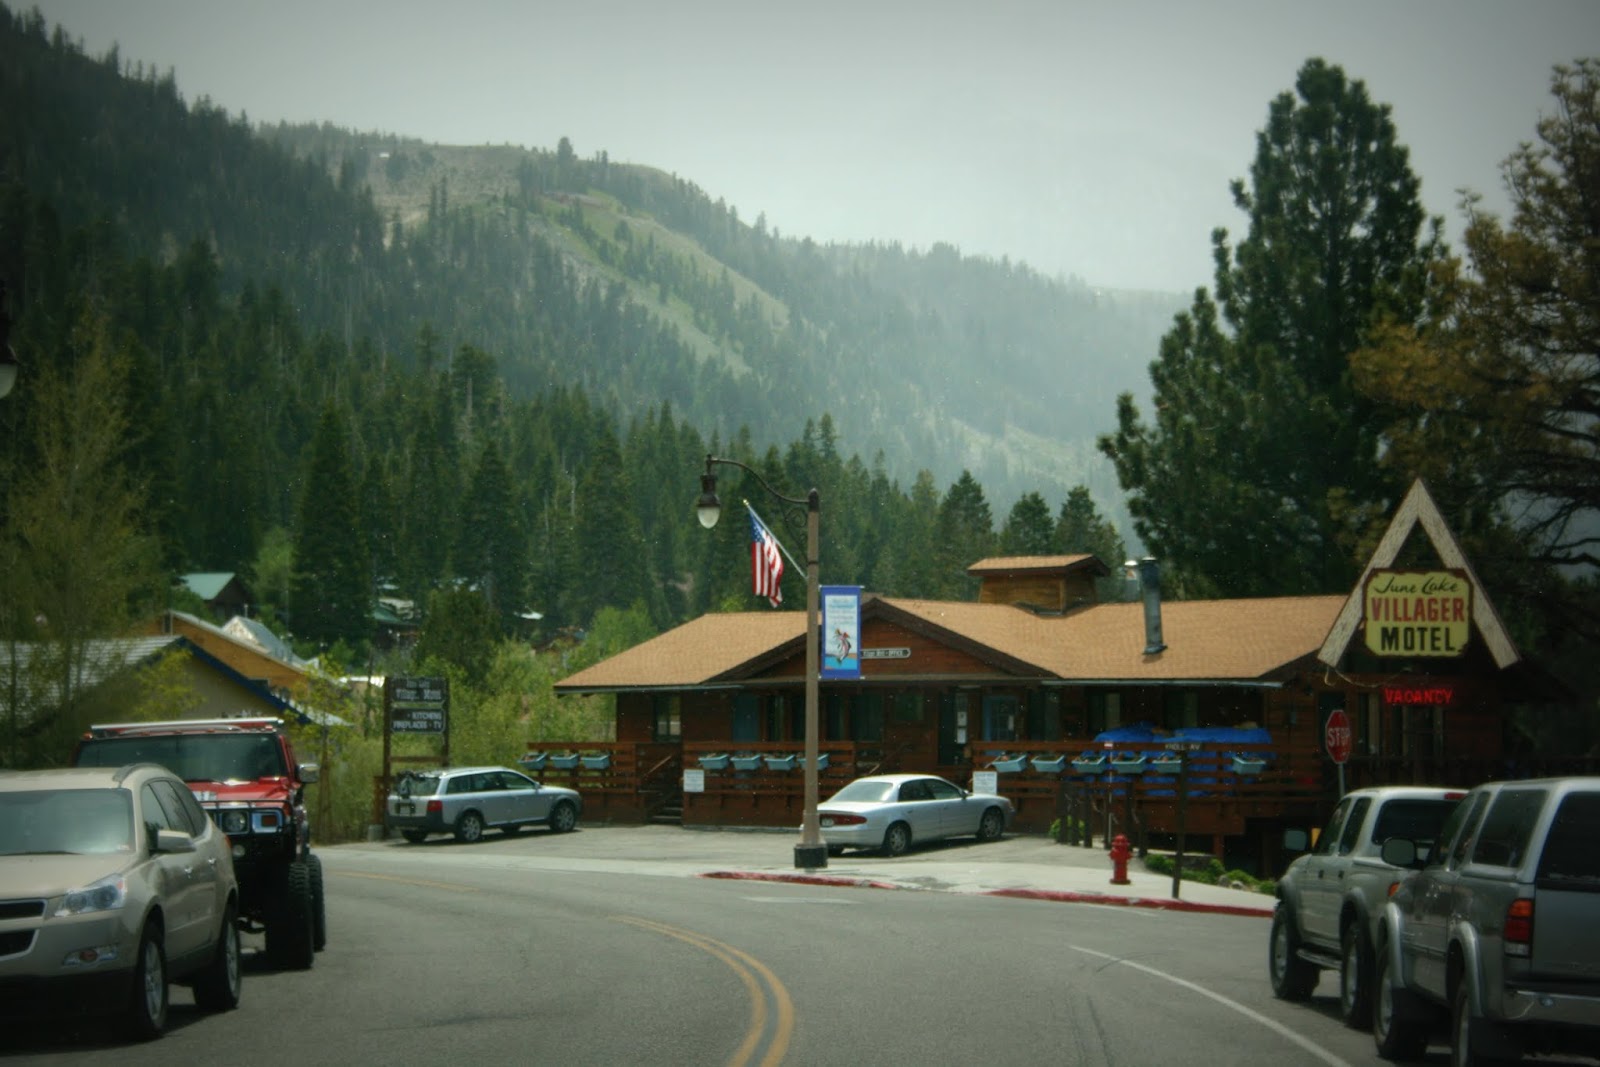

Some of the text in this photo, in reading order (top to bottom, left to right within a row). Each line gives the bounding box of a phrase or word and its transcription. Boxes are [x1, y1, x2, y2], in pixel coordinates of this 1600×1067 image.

[1374, 576, 1459, 595] June Lake
[1371, 597, 1465, 622] VILLAGER
[1380, 626, 1456, 652] MOTEL
[1384, 688, 1453, 704] VACANCY
